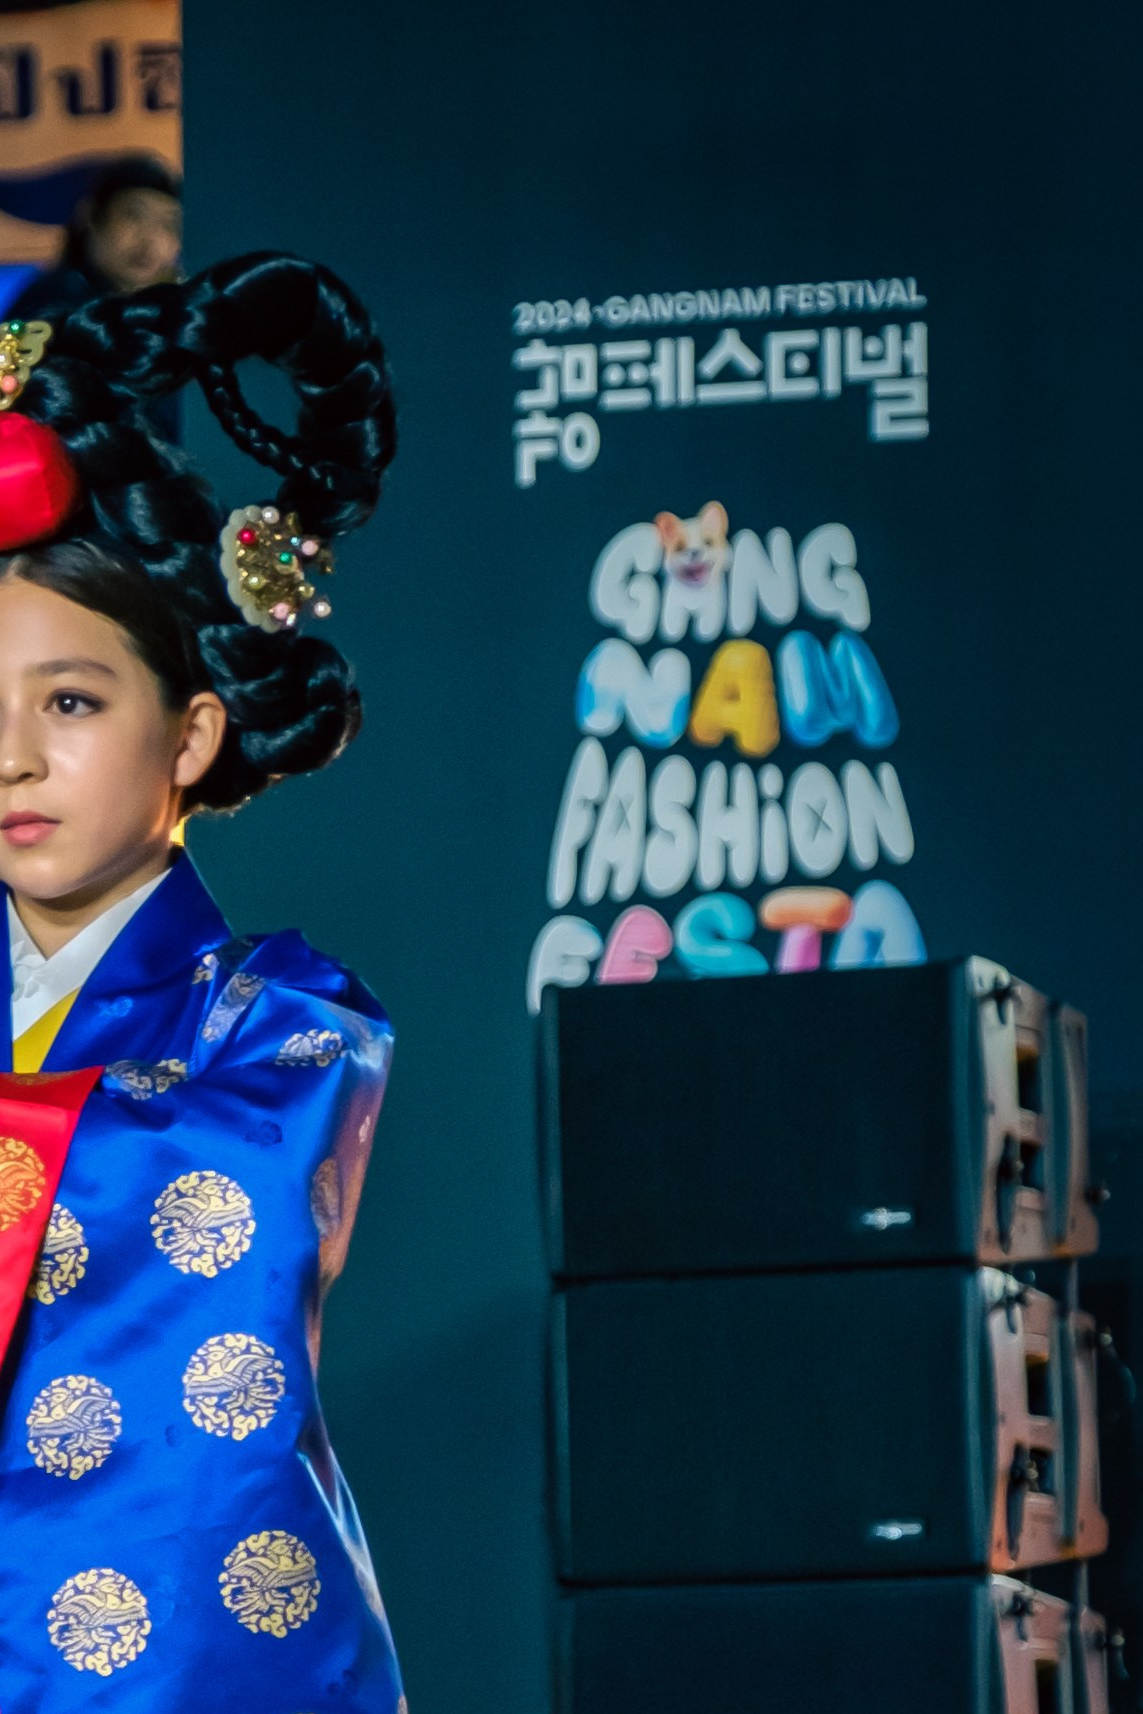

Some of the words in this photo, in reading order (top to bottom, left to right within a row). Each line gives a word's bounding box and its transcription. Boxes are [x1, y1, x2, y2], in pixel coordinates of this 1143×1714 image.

[775, 276, 928, 315] FESTIVAL
[589, 505, 871, 644] GANG
[575, 630, 900, 757] NAM
[526, 880, 928, 1017] FESTA
